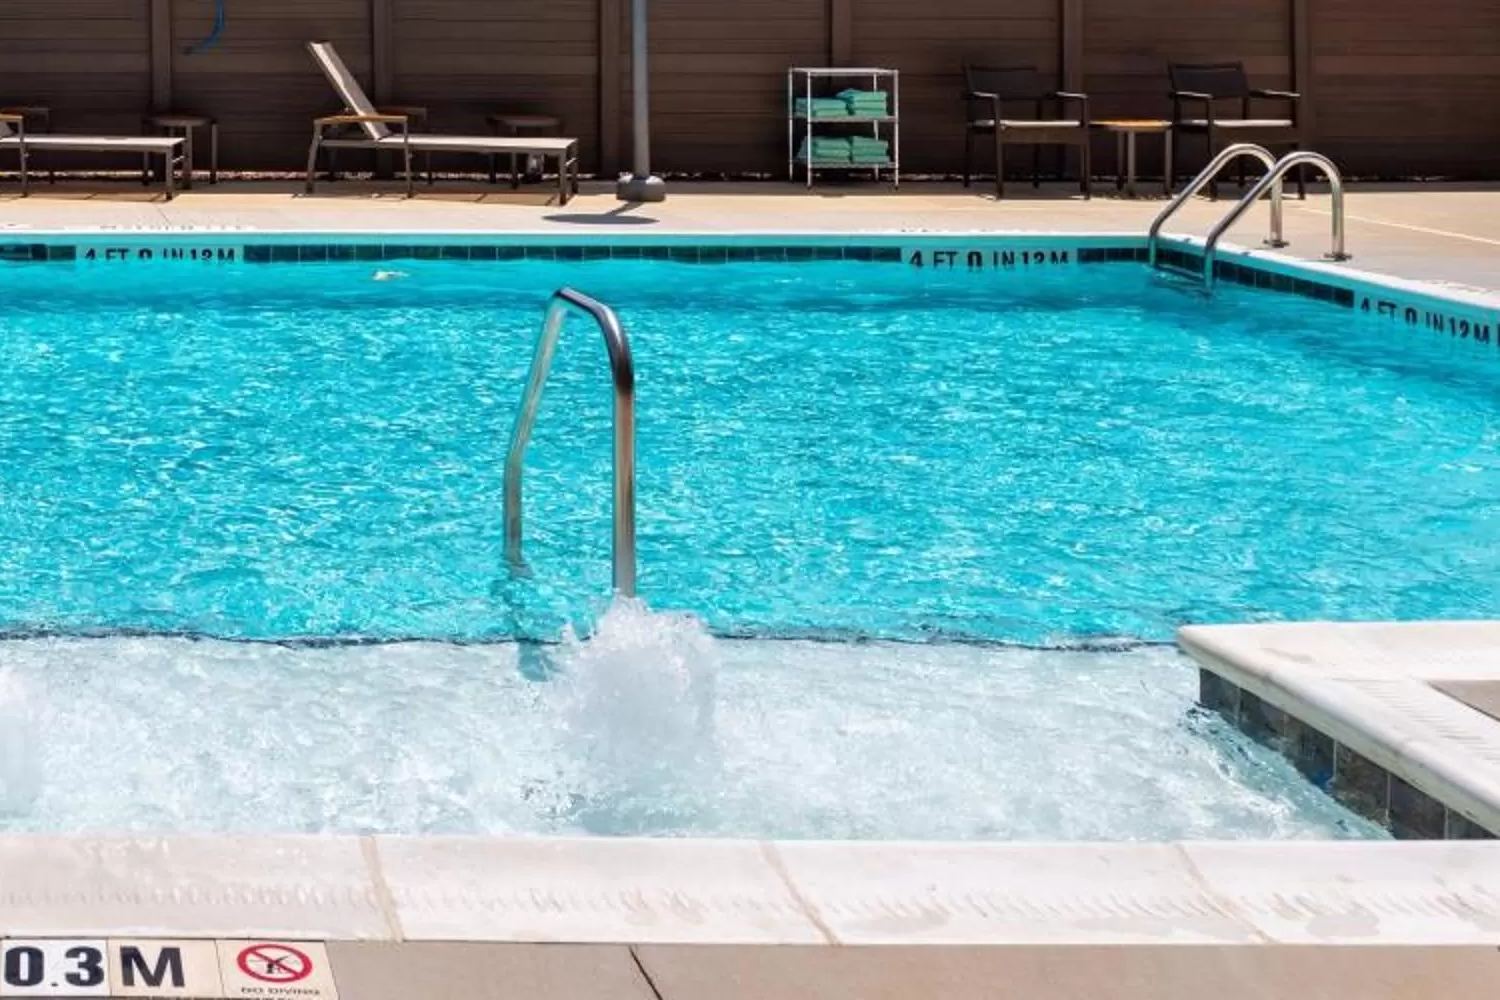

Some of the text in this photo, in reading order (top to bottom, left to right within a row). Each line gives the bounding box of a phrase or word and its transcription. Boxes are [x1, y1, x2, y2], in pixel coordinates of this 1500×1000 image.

[84, 248, 96, 261] 4
[105, 248, 130, 261] FT
[910, 250, 924, 267] 4
[933, 251, 958, 268] FT
[3, 946, 105, 988] 0.3
[119, 946, 185, 988] M
